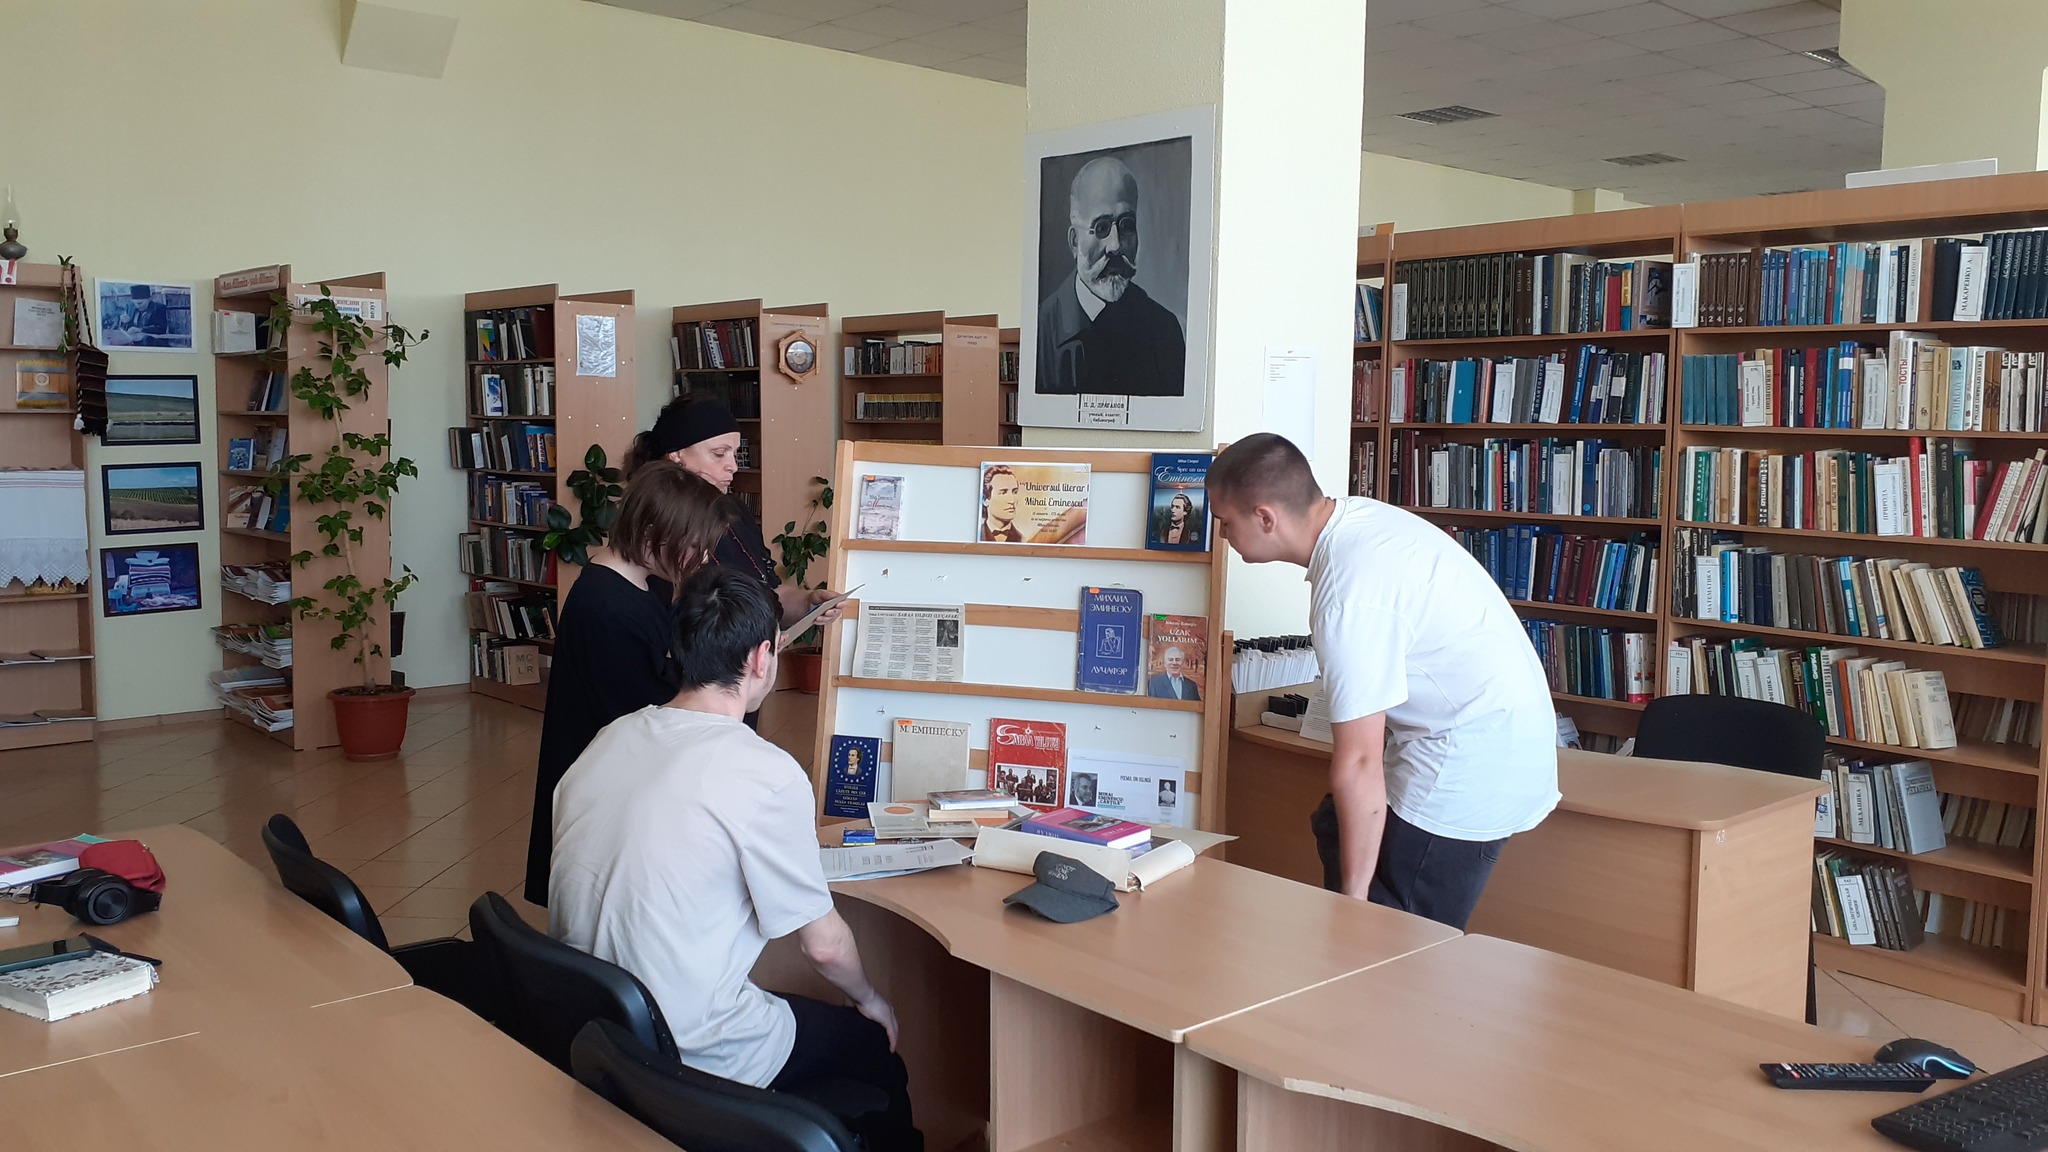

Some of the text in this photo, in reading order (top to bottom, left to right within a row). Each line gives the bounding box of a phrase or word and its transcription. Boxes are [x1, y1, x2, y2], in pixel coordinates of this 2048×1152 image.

[1961, 267, 1972, 311] МАКАРЕНКО
[1899, 359, 1908, 386] ТОСТЫ
[1062, 483, 1084, 492] literar
[1025, 497, 1046, 506] Mihai
[1094, 594, 1129, 603] МИХАИЛ
[1090, 604, 1132, 613] ЭМИНЕСКУ
[1158, 635, 1197, 644] YOLLARIM
[1091, 666, 1128, 675] ЛУЧАФЭР
[1822, 654, 1832, 696] ФИЗИКИ
[912, 726, 965, 737] ЕМИНЕСКУ
